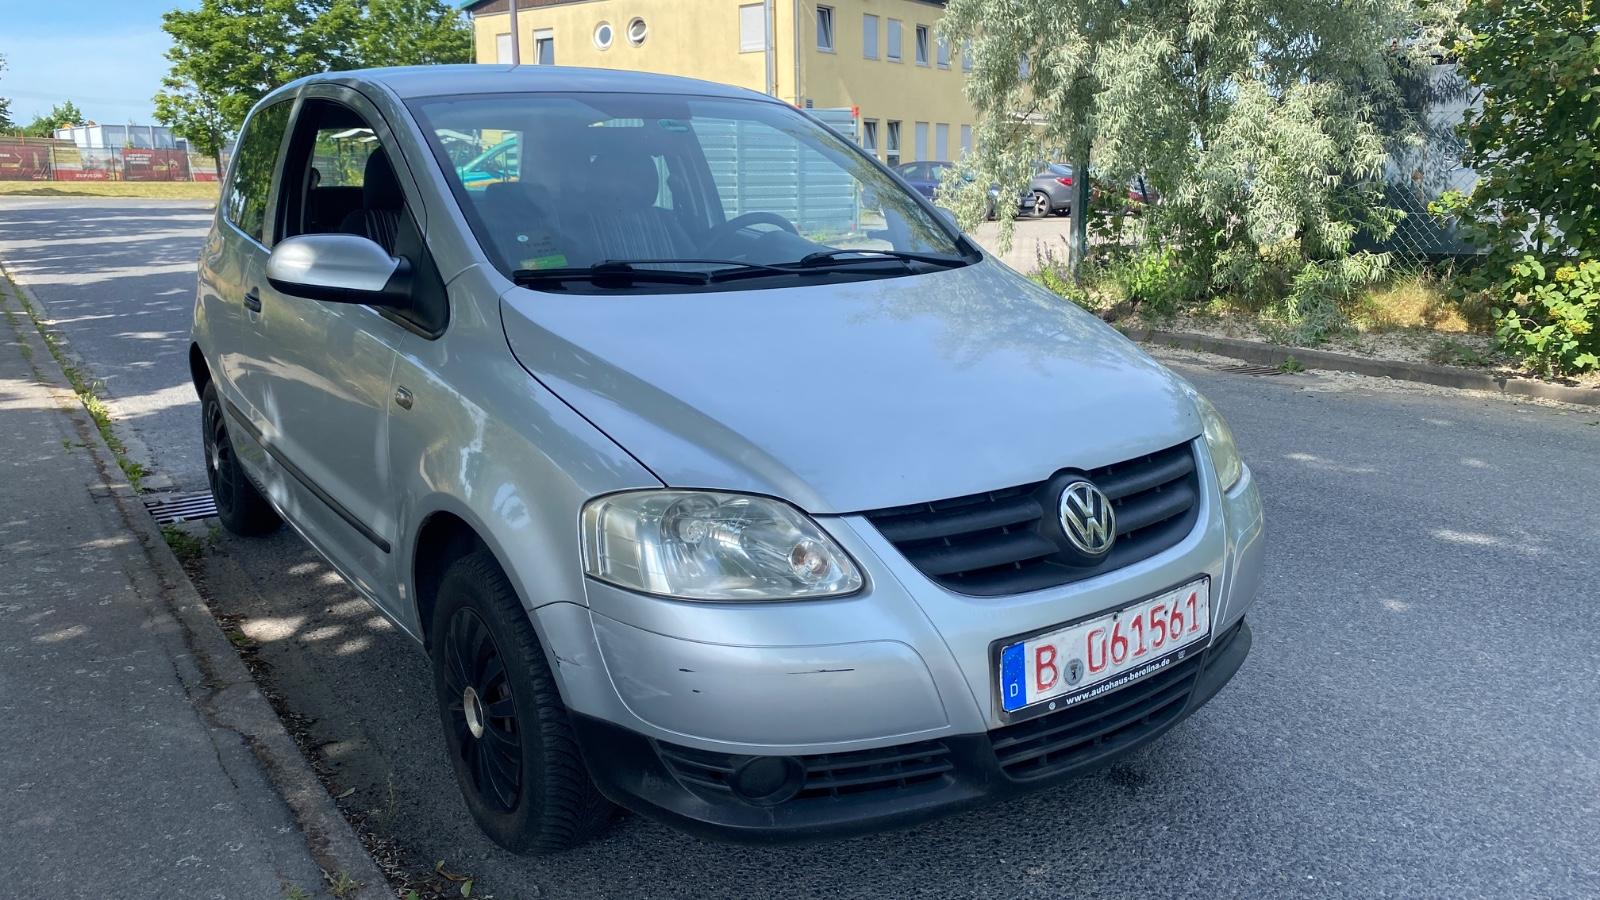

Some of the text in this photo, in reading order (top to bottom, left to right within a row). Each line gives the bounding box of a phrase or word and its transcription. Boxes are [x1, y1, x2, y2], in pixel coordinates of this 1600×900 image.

[1061, 482, 1116, 554] VW
[1035, 591, 1200, 693] B 061561
[1010, 683, 1018, 698] D
[1066, 658, 1171, 705] www.autohaus-berolina.de
